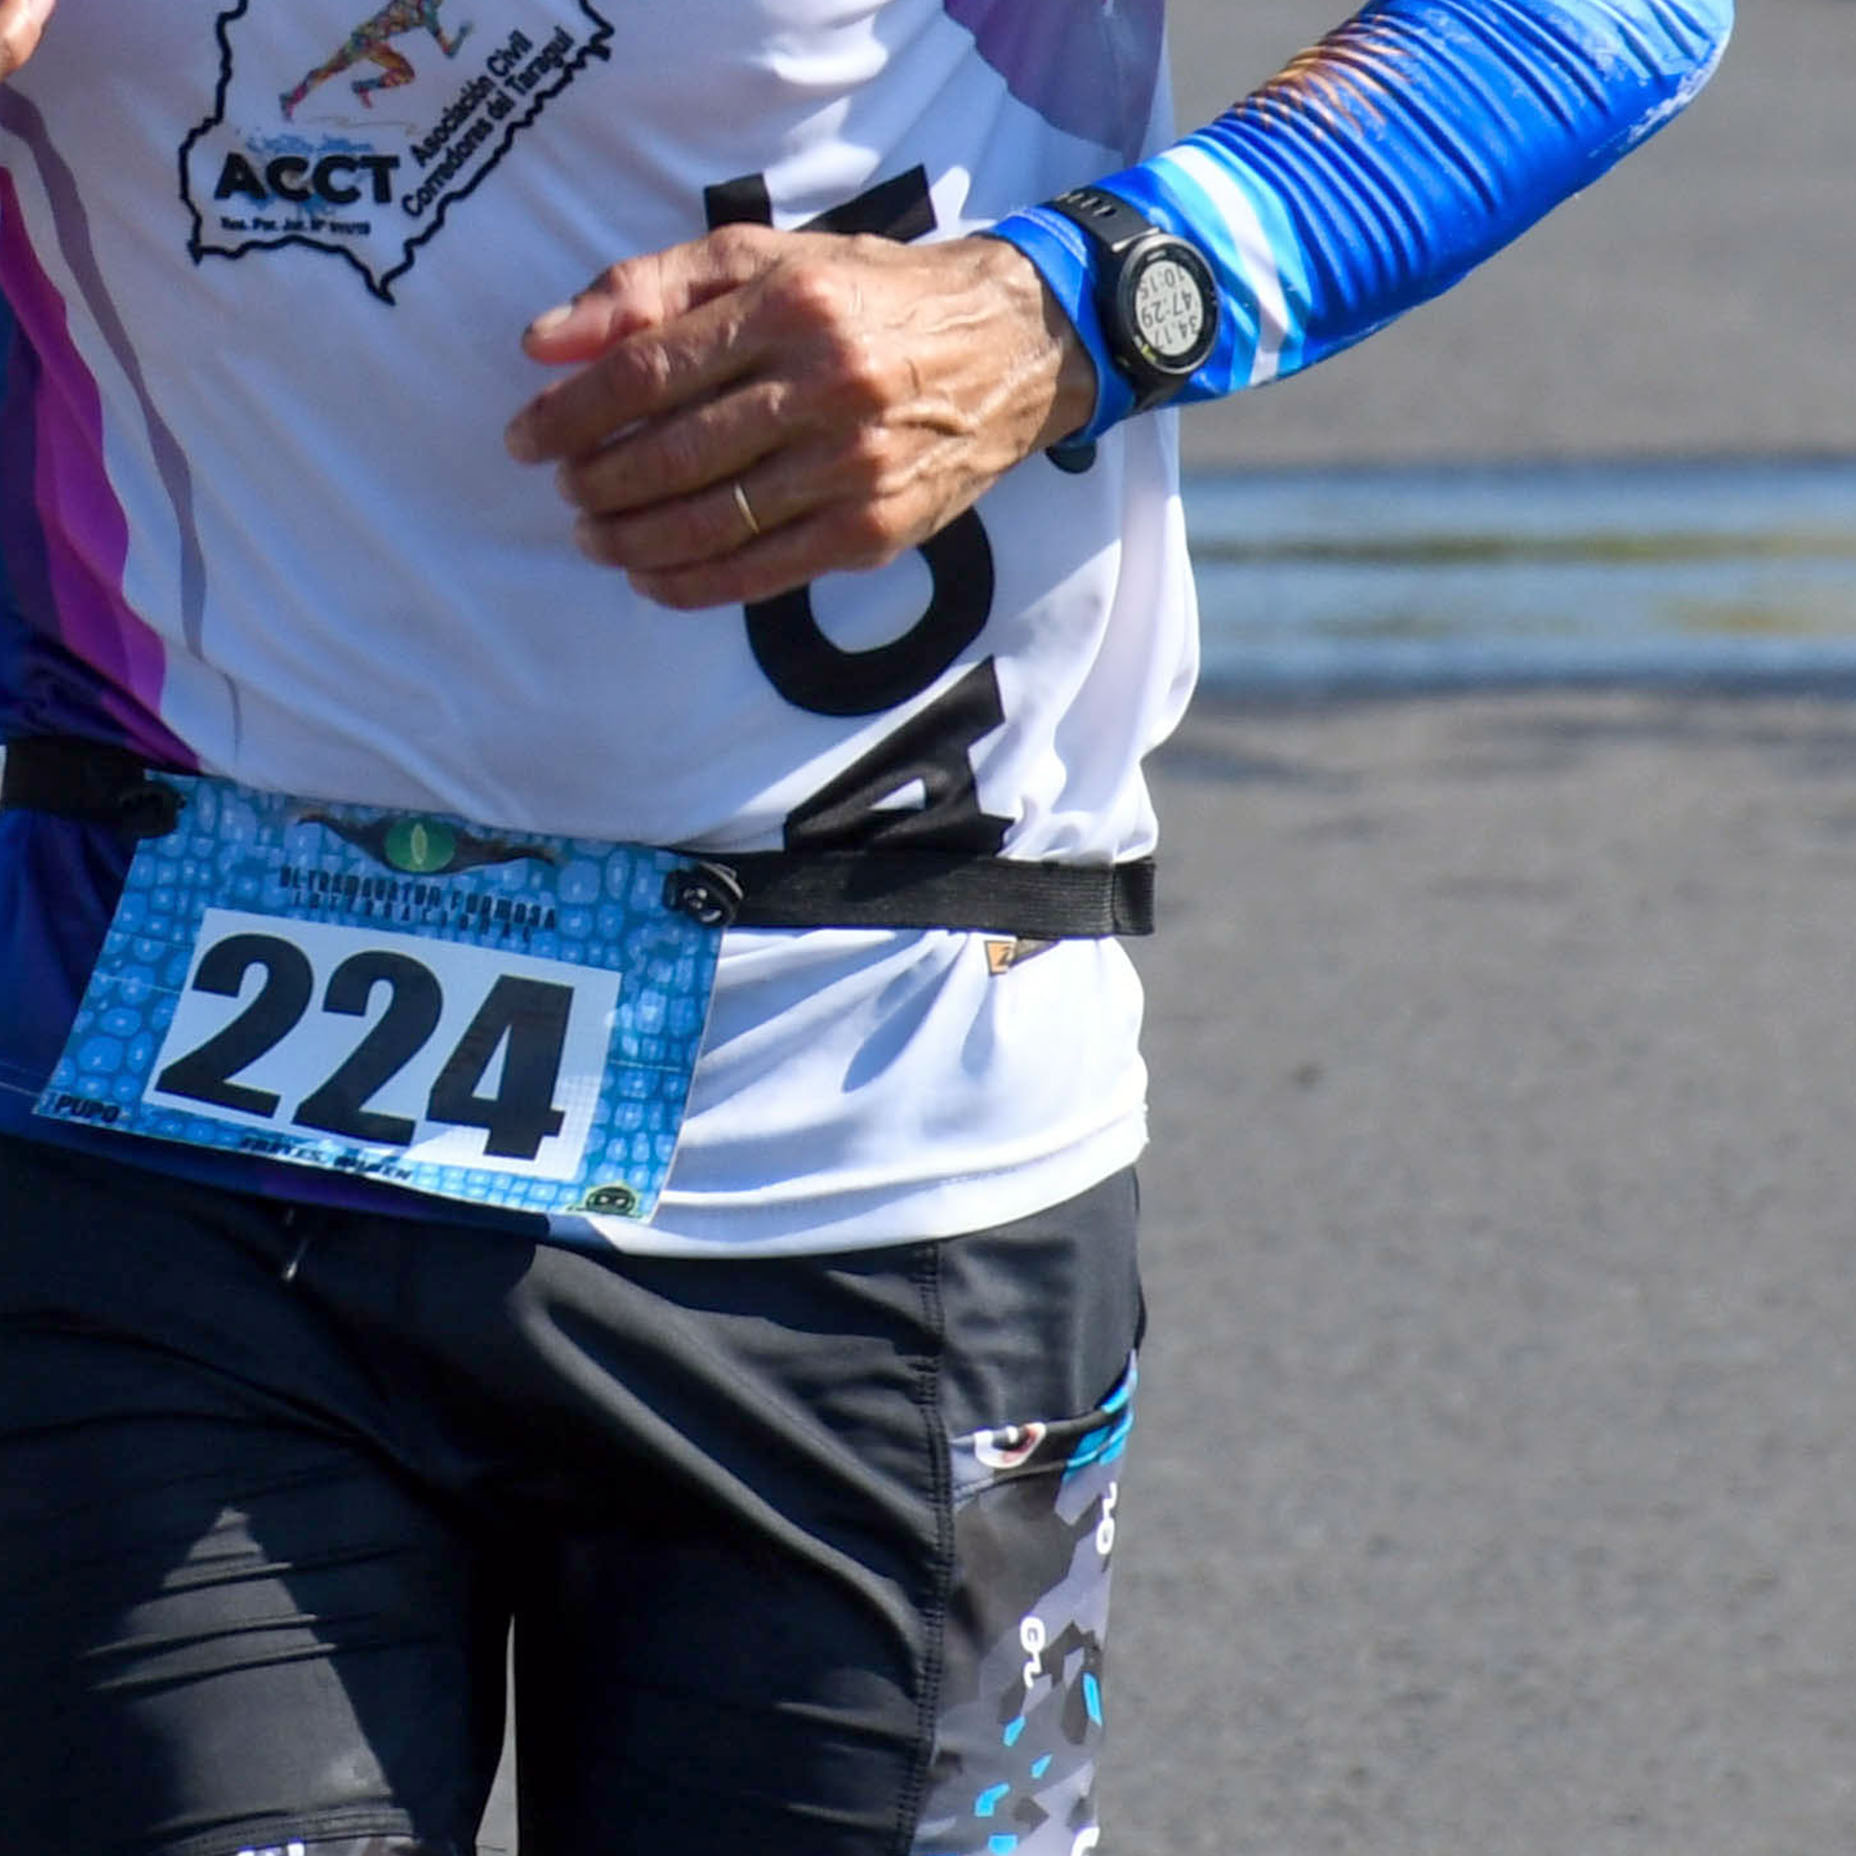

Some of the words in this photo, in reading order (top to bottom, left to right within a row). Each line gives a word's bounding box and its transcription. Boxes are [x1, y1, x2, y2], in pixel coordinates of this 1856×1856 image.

[486, 29, 534, 78] Civil
[487, 89, 517, 120] del
[213, 152, 401, 205] ACCT
[154, 933, 575, 1162] 224
